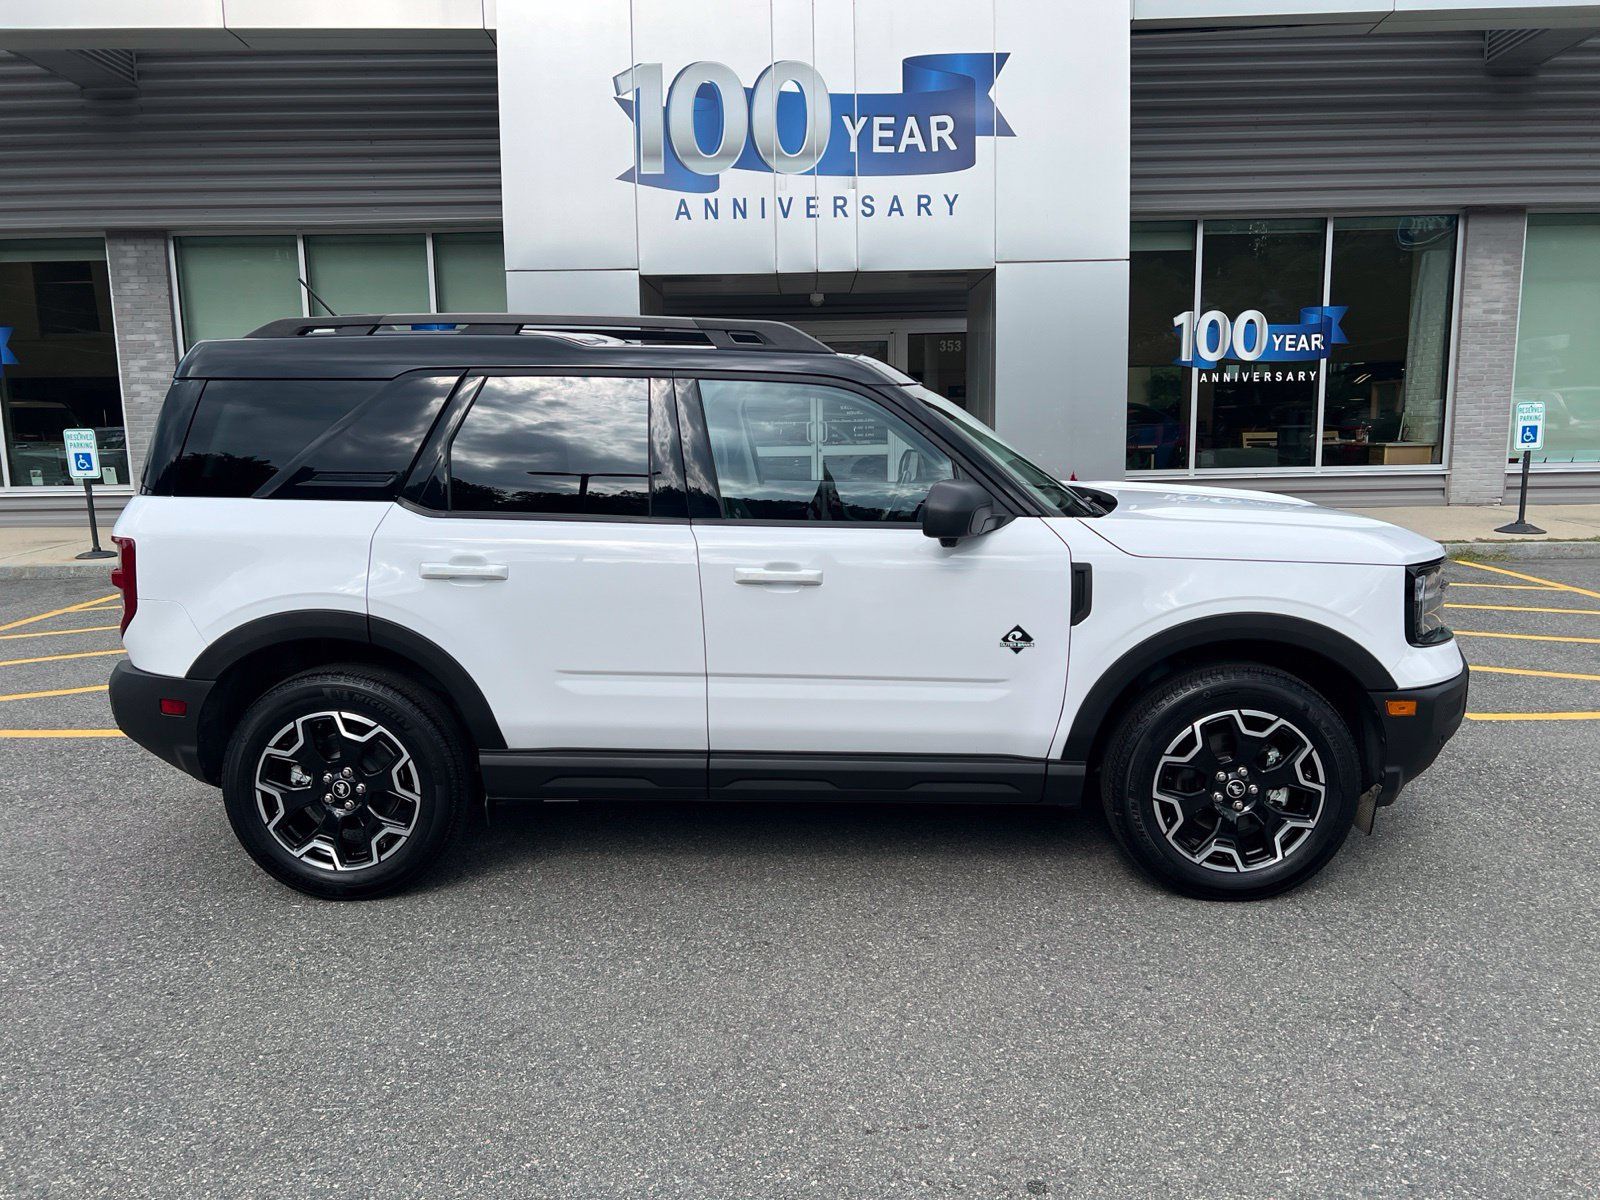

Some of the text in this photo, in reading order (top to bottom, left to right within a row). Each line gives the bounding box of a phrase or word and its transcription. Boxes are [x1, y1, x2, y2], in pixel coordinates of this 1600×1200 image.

[612, 60, 958, 175] 100 YEAR
[675, 193, 960, 221] ANNIVERSARY
[940, 340, 961, 352] 353
[1173, 309, 1325, 362] 100 YEAR
[1200, 371, 1317, 383] ANNIVERSARY
